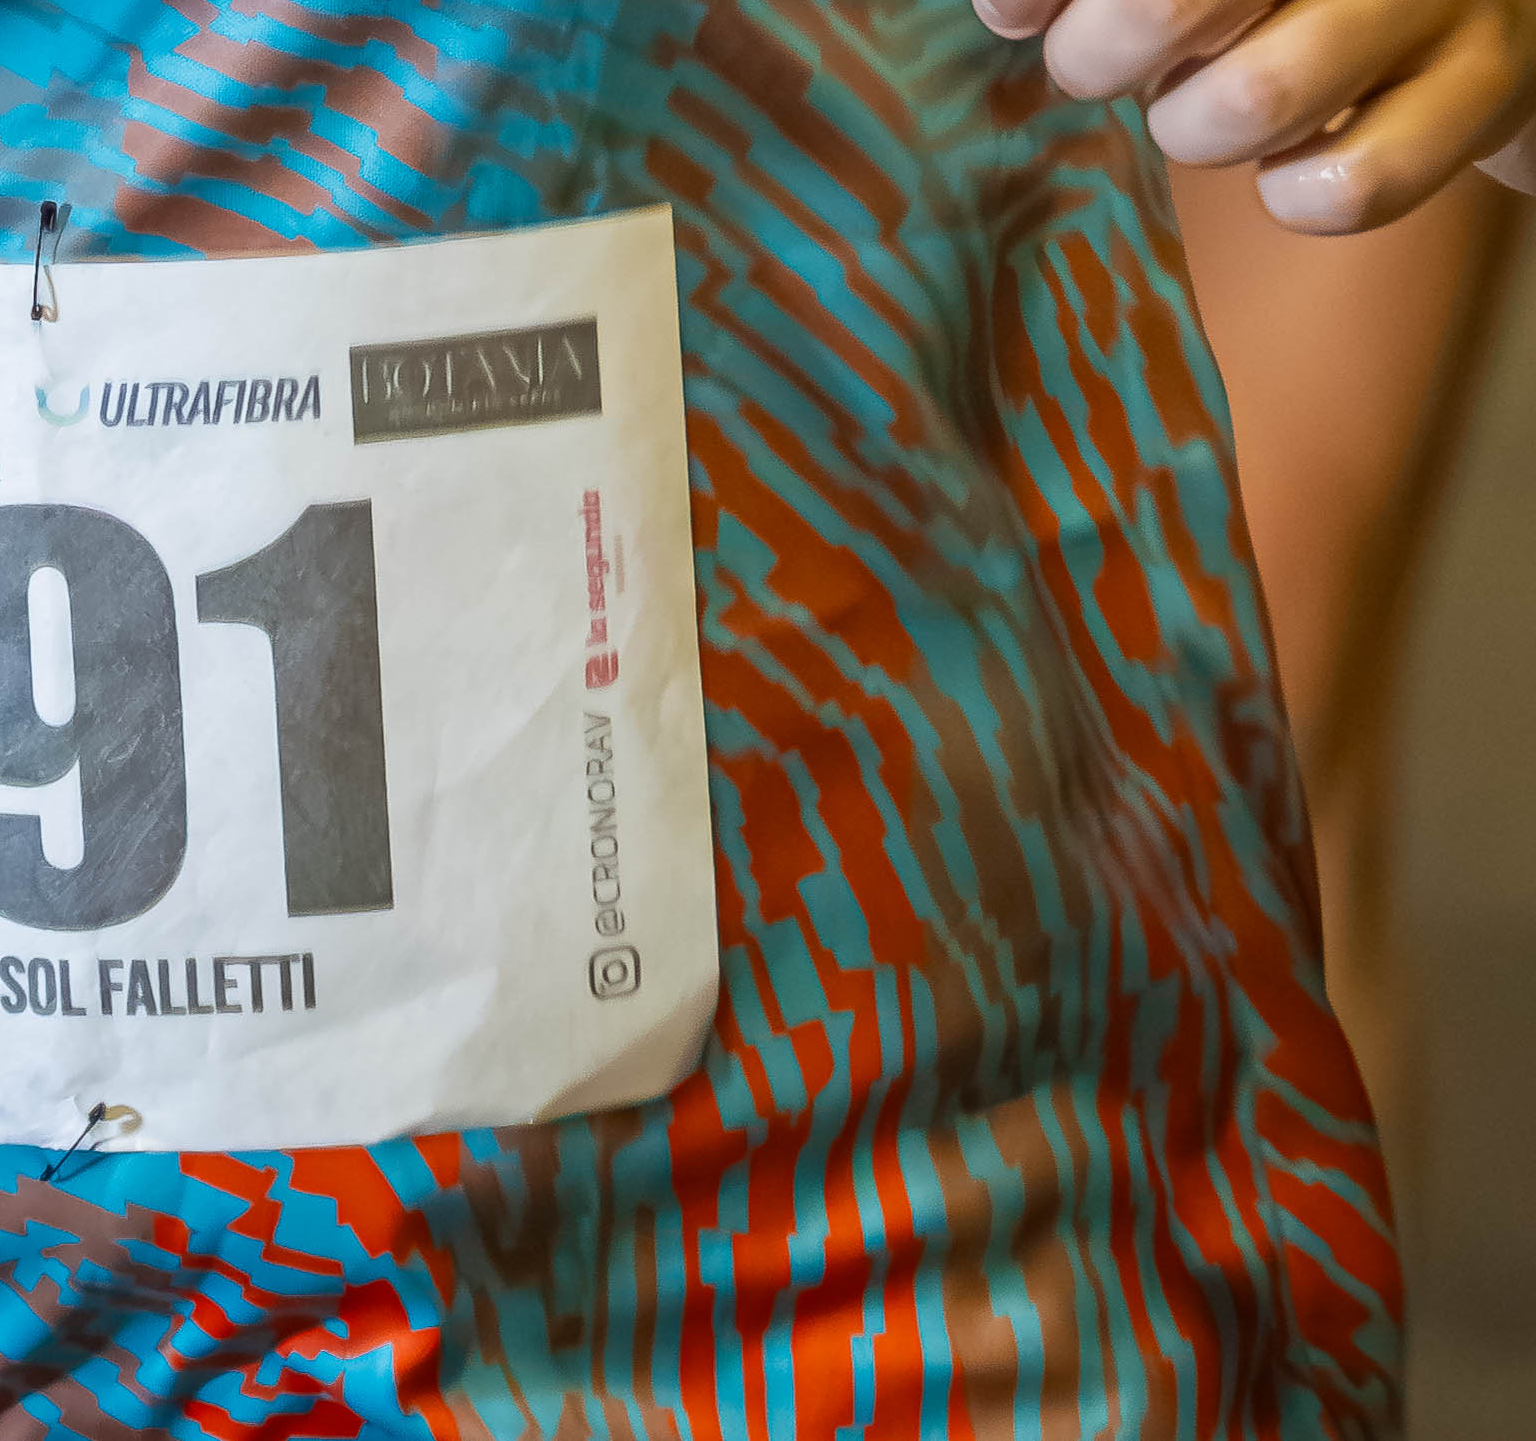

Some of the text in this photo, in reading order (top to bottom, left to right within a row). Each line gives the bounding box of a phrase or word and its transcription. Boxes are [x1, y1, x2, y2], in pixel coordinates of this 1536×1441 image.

[99, 375, 320, 428] ULTRAFIBRA
[583, 711, 625, 936] @CRONORAV
[0, 955, 87, 1016] SOL
[99, 952, 316, 1016] FALLETTI
